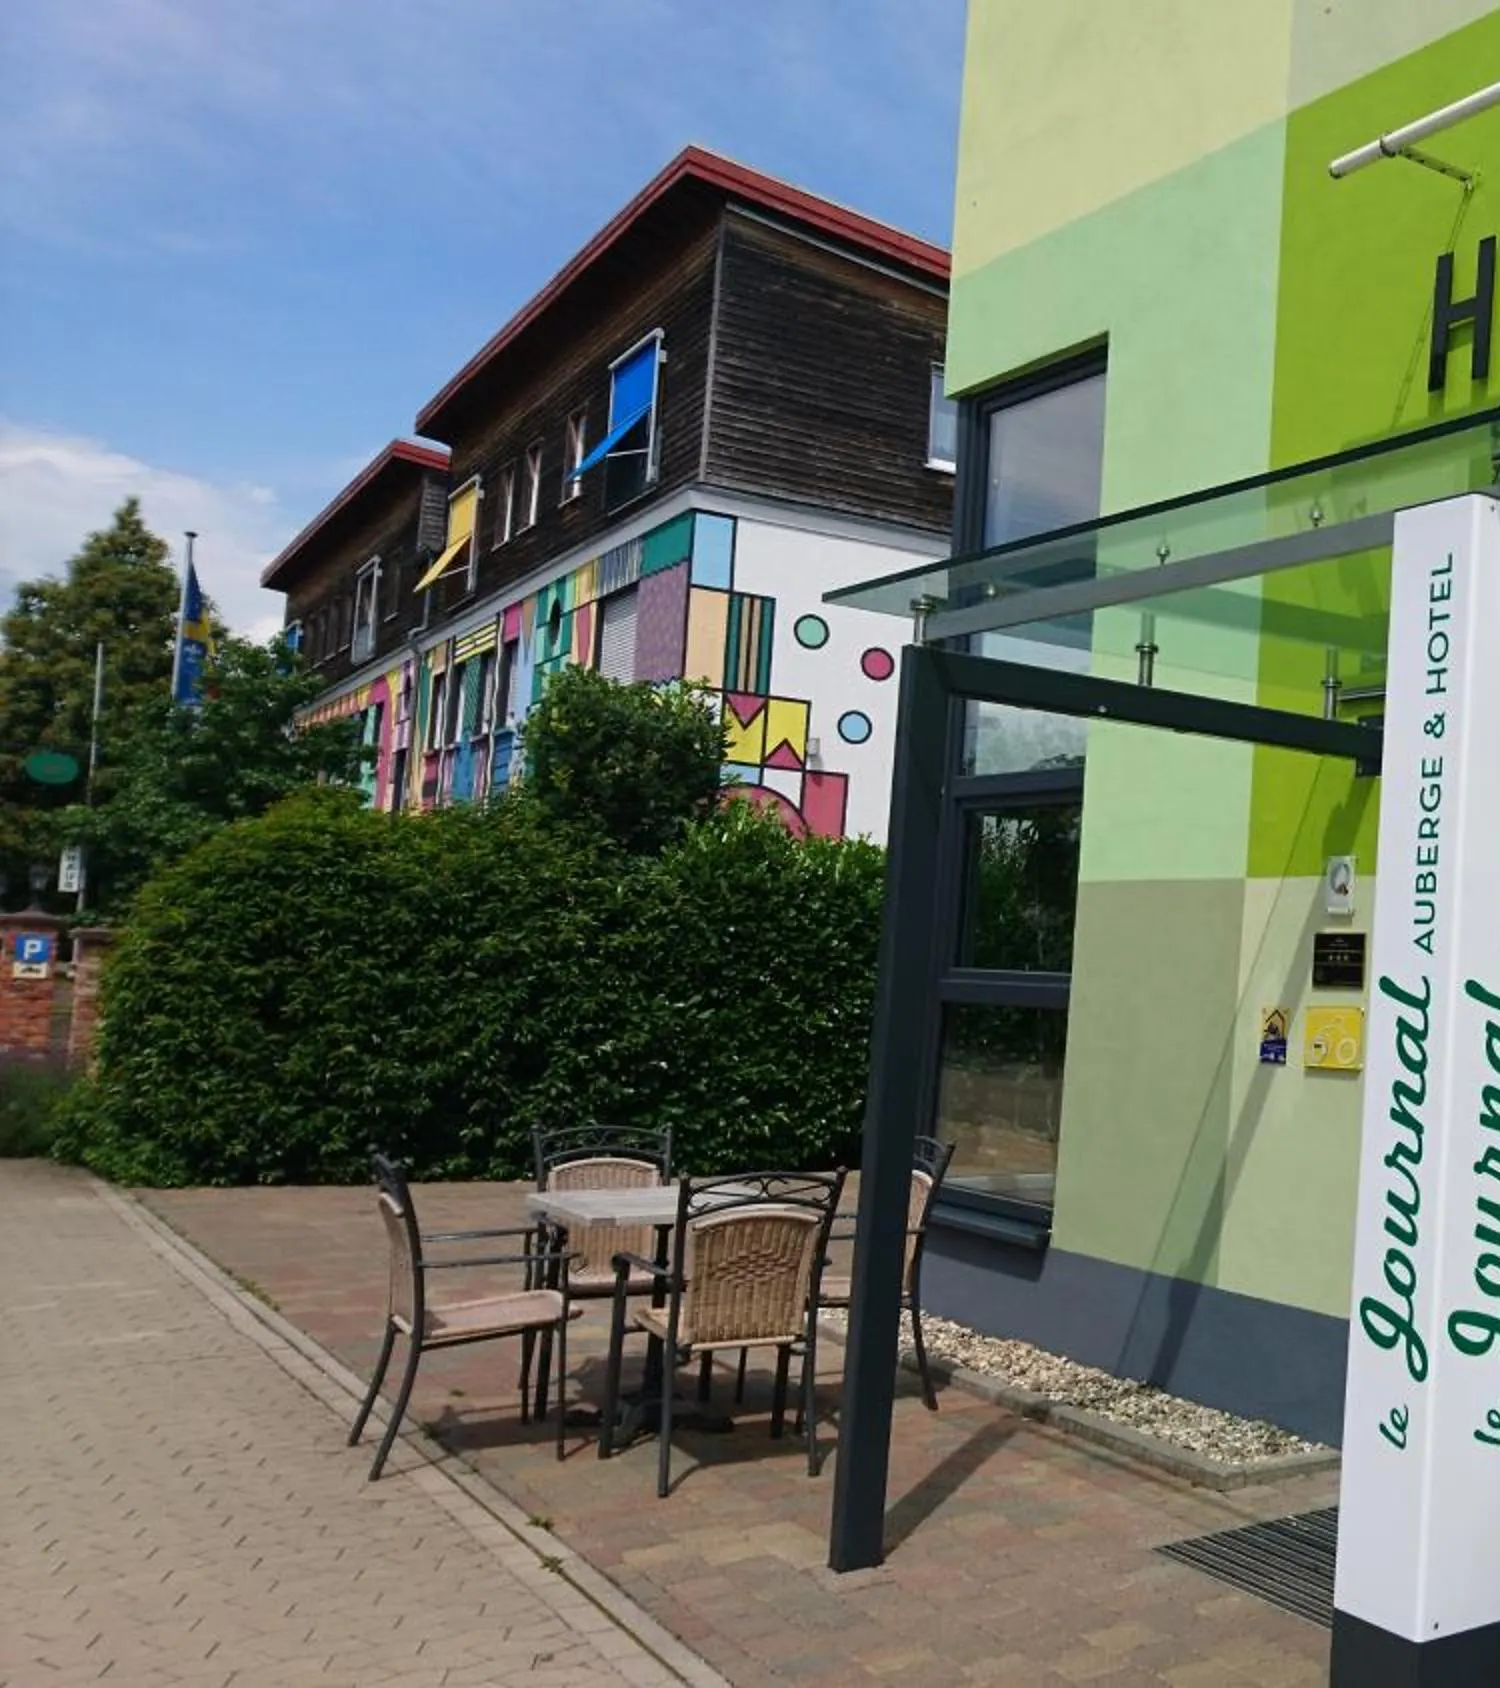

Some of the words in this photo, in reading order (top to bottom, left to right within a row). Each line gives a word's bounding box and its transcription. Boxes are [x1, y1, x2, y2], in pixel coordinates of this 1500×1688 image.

[1425, 552, 1453, 695] HOTEL
[1424, 712, 1446, 739] &
[1414, 756, 1443, 955] AUBERGE
[23, 939, 42, 960] P
[1360, 975, 1431, 1383] Journal
[1379, 1404, 1409, 1450] le
